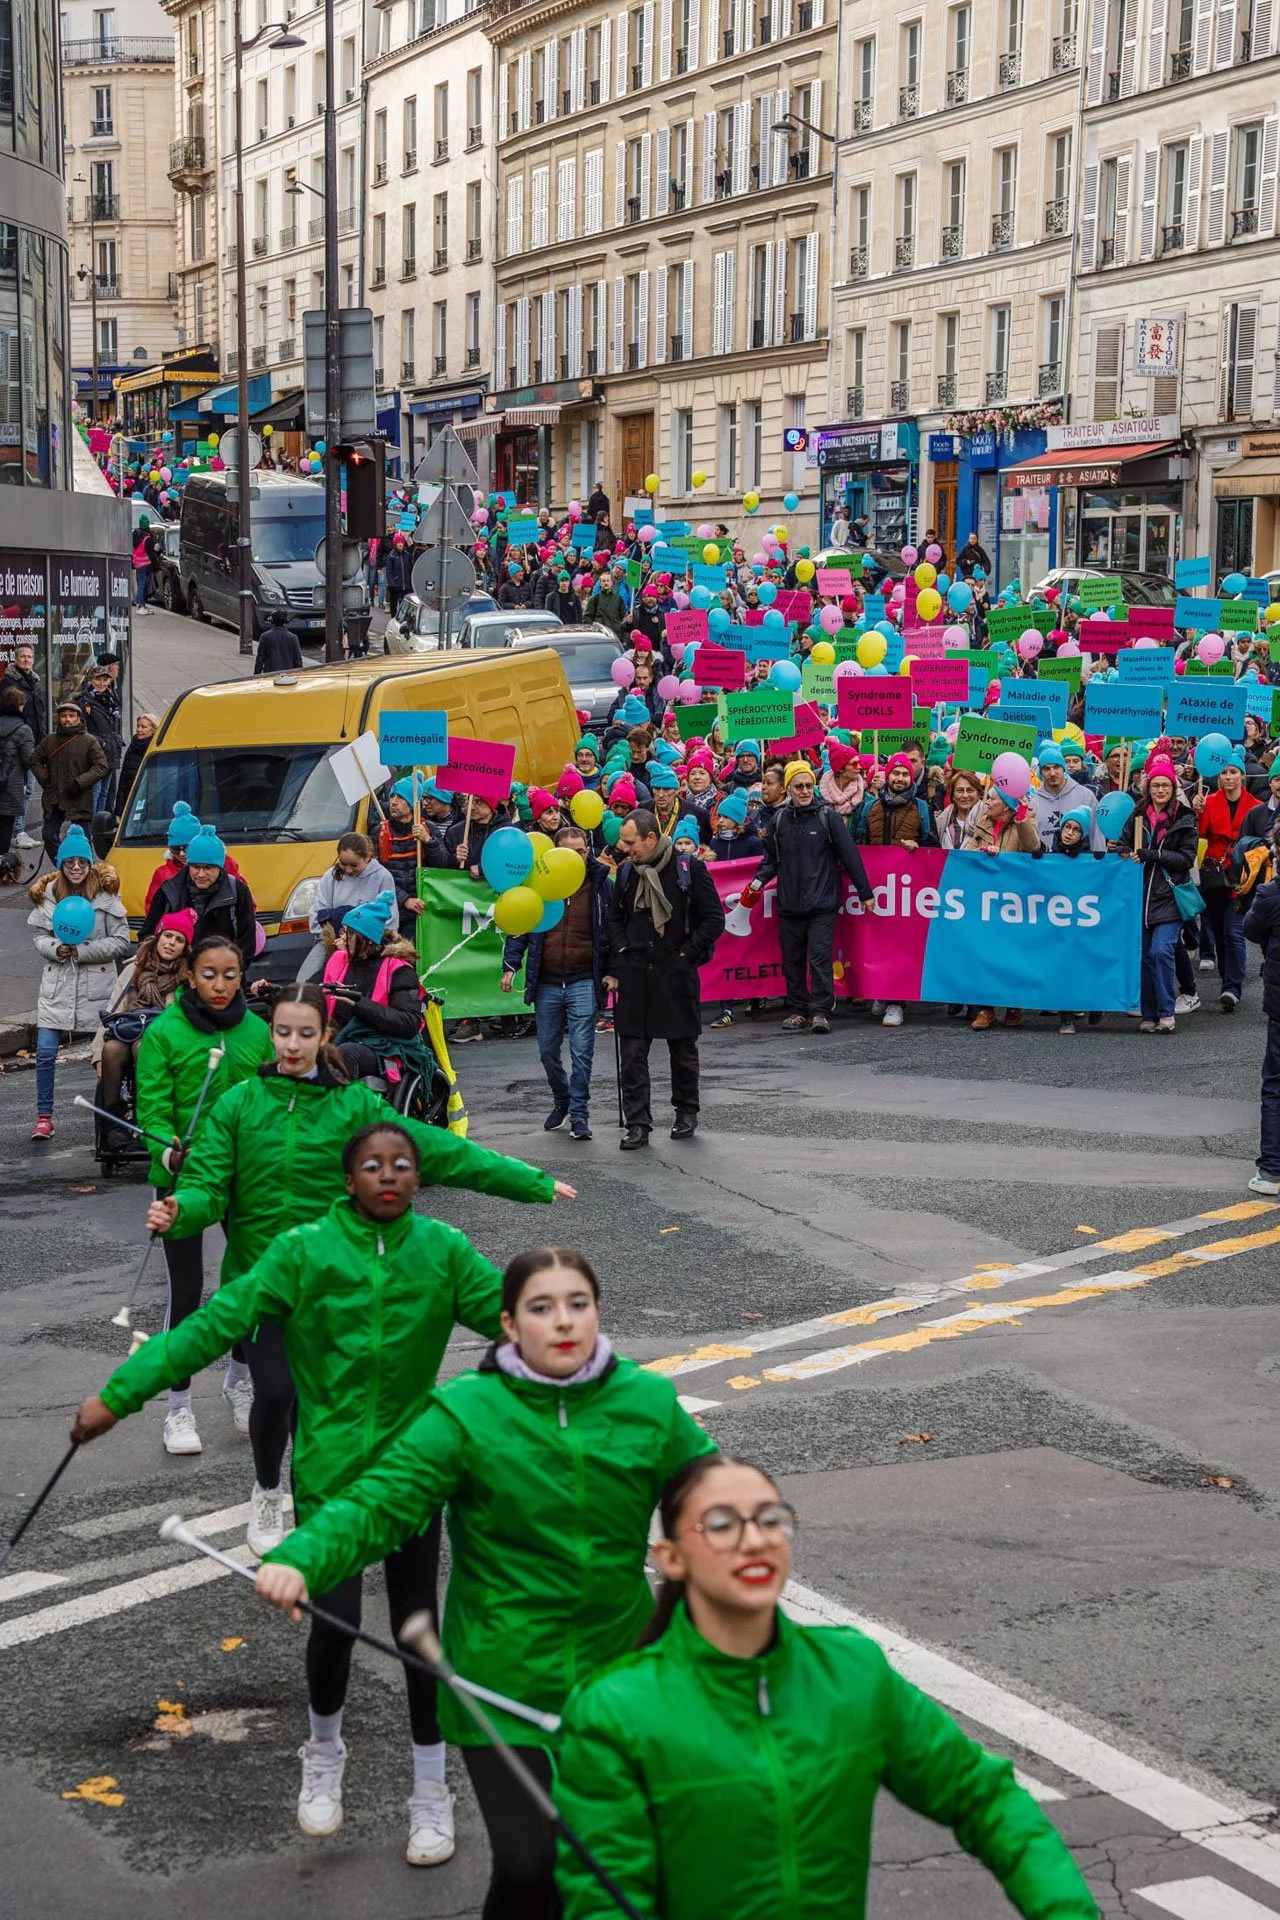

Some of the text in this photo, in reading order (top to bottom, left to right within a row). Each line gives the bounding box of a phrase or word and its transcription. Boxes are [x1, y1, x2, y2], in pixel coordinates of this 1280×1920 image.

[1139, 319, 1147, 364] TRAITEUR
[1166, 320, 1174, 365] ASIATIQUE
[1062, 418, 1161, 439] TRAITEUR ASIATIQUE
[972, 446, 992, 456] minute
[1016, 473, 1051, 485] TRAITEUR
[5, 568, 15, 596] de
[16, 568, 44, 596] maison
[60, 569, 100, 597] Le luminaire
[1184, 609, 1212, 618] Amylose
[989, 616, 1021, 626] Syndrome
[990, 624, 1034, 636] Lesch-Nyhan
[1040, 667, 1071, 676] Syndrome
[848, 690, 902, 702] Syndrome
[1007, 691, 1060, 702] Maladie de
[728, 702, 792, 715] SPHÉROCYTOSE
[1180, 697, 1234, 710] Ataxie de
[1003, 712, 1037, 722] Délétion
[1087, 705, 1161, 718] Hypoparathyroïdie
[734, 714, 788, 726] HÉRÉDITAIRE
[1177, 712, 1234, 726] Friedreich
[382, 733, 445, 746] Acromégalie
[960, 730, 1032, 750] Syndrome de
[446, 759, 505, 777] Sarcoïdose
[980, 892, 1101, 928] rares
[58, 923, 80, 937] 3637
[722, 963, 786, 982] TELET
